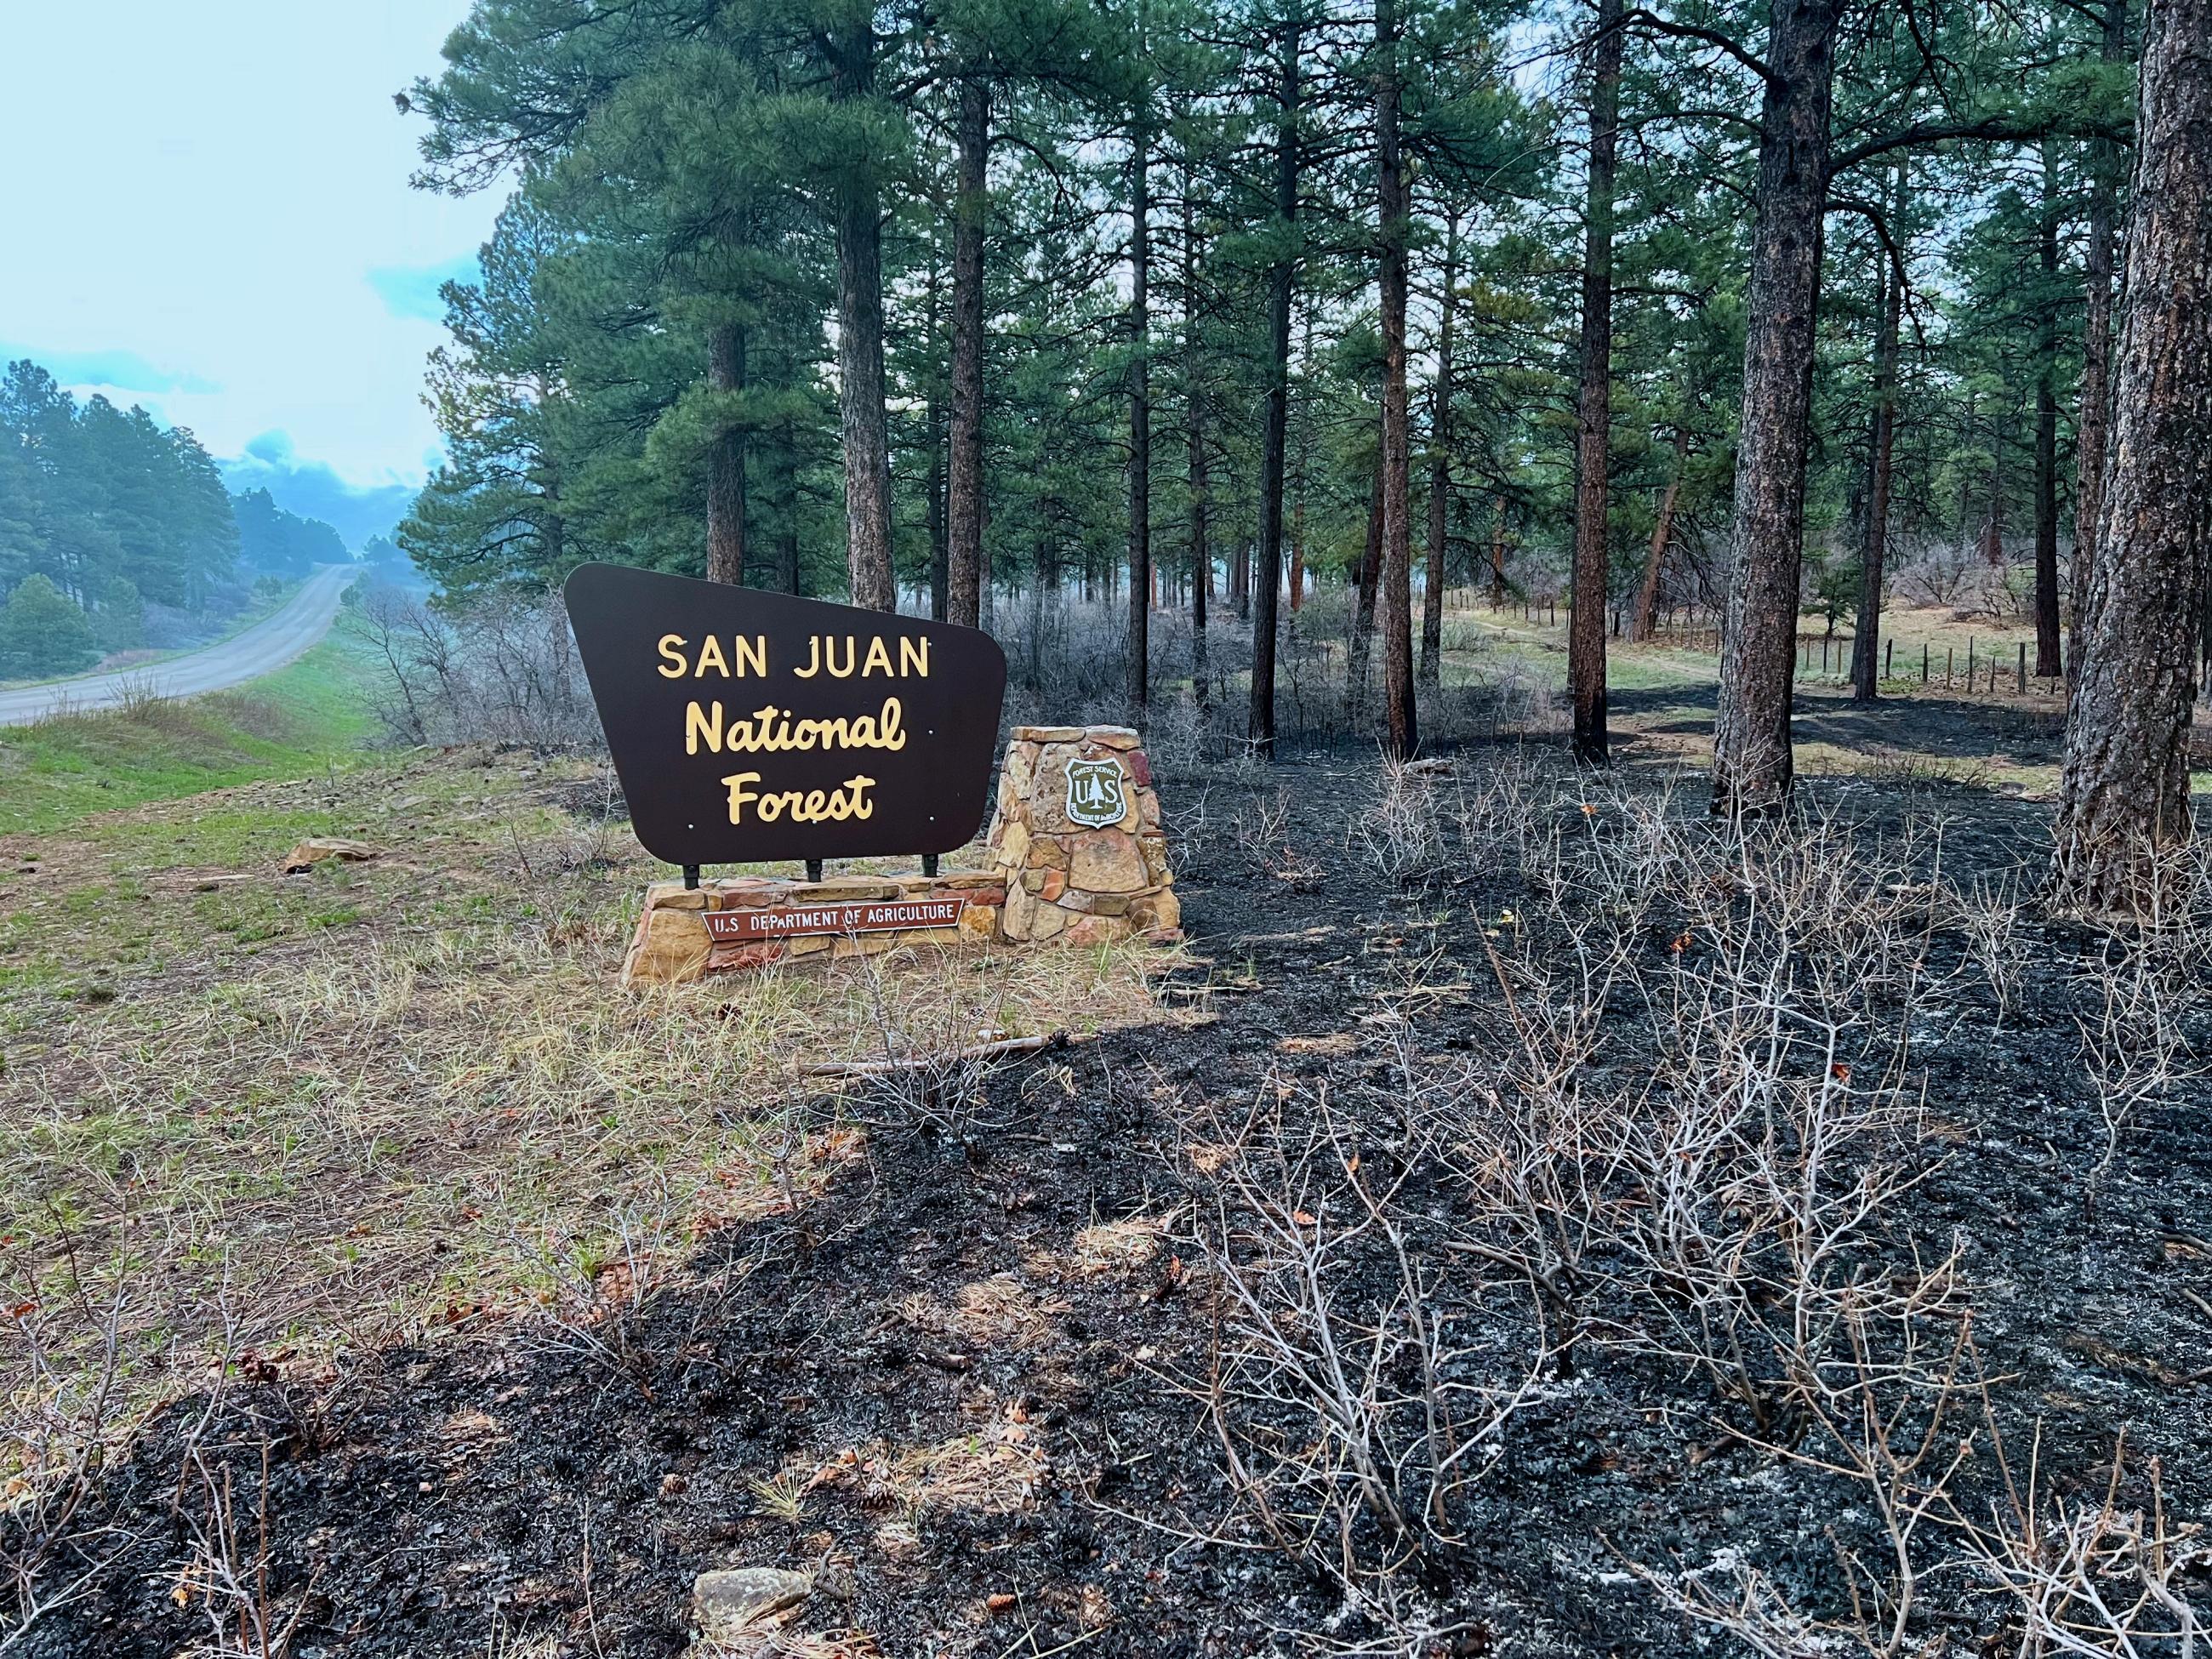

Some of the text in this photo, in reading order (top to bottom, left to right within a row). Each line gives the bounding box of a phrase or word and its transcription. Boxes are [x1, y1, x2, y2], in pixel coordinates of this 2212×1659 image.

[657, 634, 929, 679] SAN JUAN
[685, 696, 906, 755] National
[1073, 766, 1118, 778] FOREST SERVICE
[721, 771, 876, 825] Forest
[750, 910, 838, 931] DEPARTMENT
[844, 909, 862, 925] OF
[867, 904, 955, 924] AGRICULTURE
